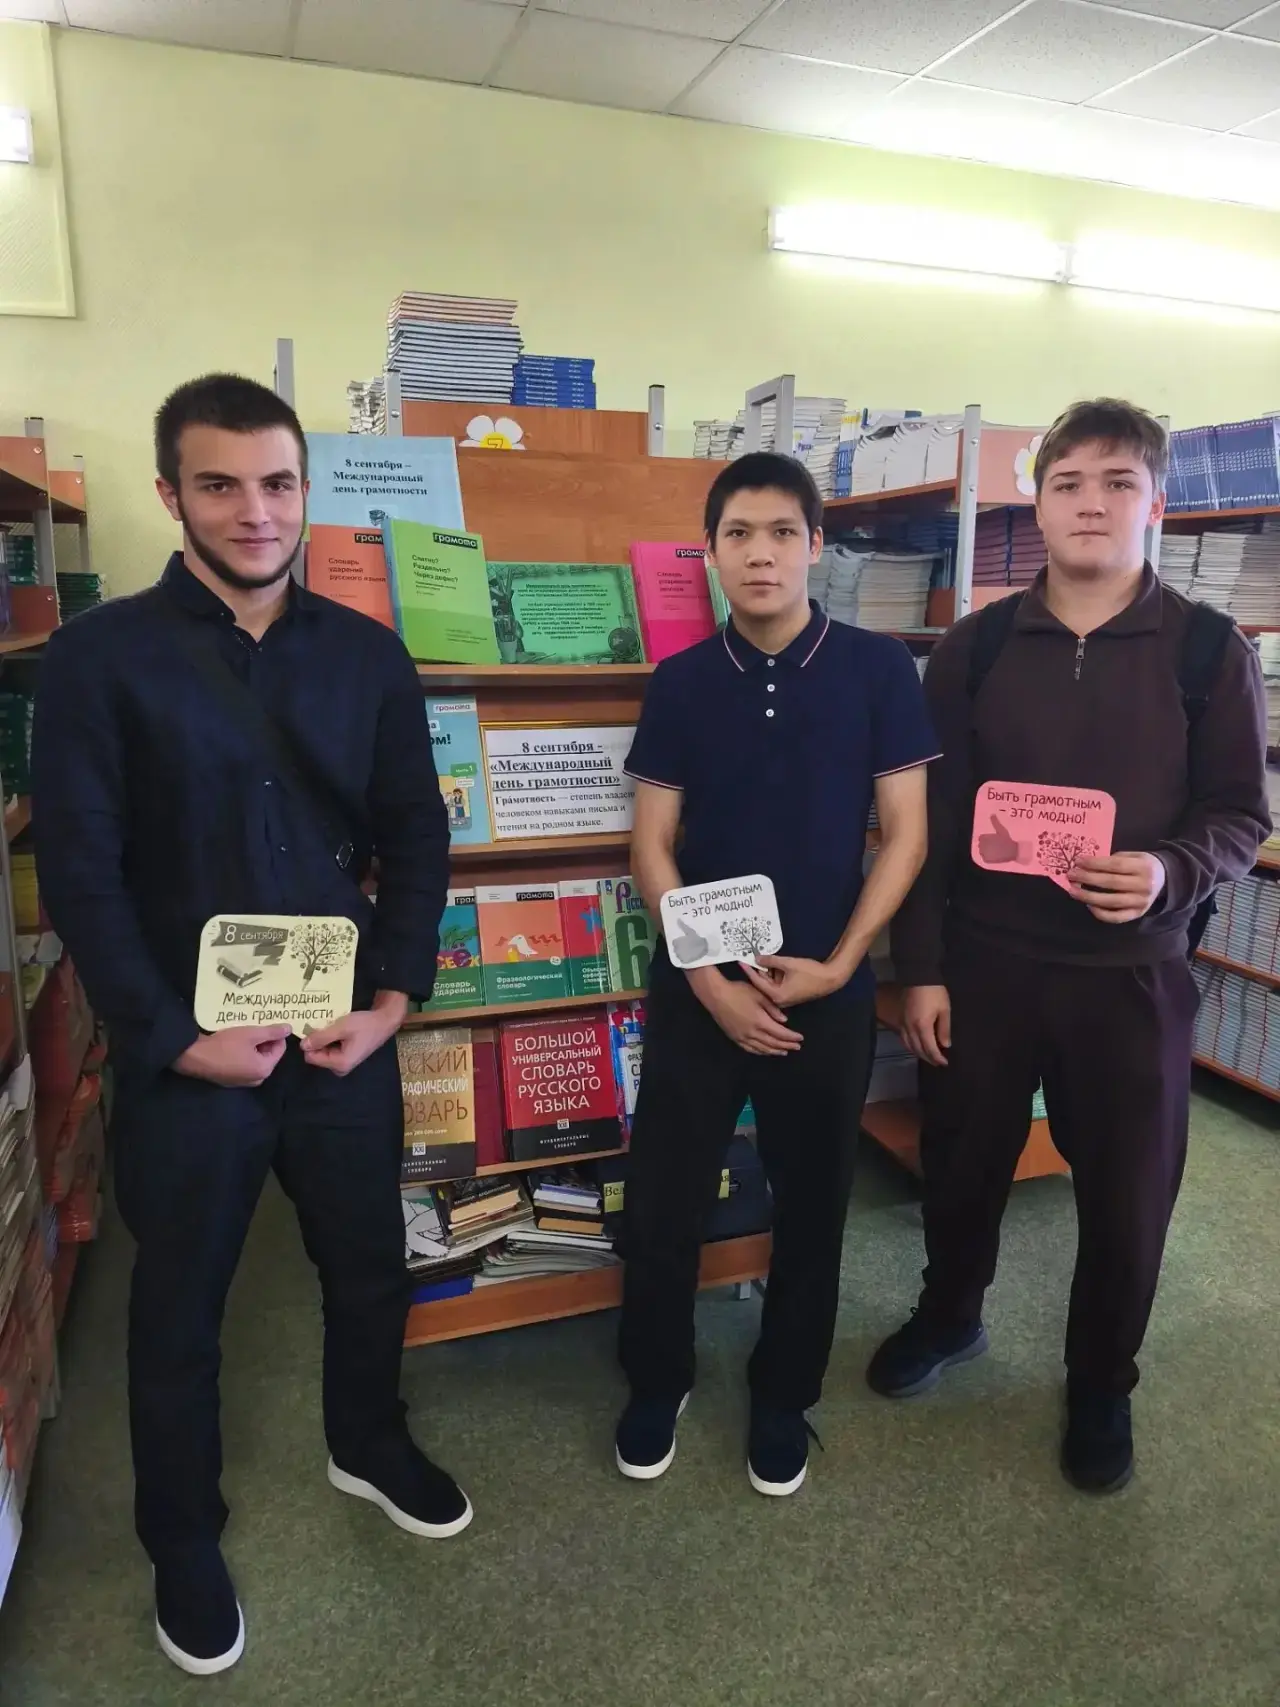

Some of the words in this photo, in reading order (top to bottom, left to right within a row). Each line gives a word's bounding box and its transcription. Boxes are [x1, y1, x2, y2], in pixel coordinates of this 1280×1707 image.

[345, 458, 352, 467] 8
[354, 460, 403, 470] сентября
[333, 471, 424, 483] Международный
[332, 485, 357, 494] день
[360, 486, 428, 496] грамотности
[356, 534, 382, 543] грам
[434, 533, 477, 548] грамота
[677, 549, 707, 557] грамо
[521, 742, 530, 754] 8
[533, 741, 594, 755] сентября
[489, 757, 613, 774] «Международный
[492, 778, 524, 791] день
[527, 775, 621, 790] грамотности»
[570, 793, 603, 801] степень
[987, 787, 1020, 803] Быть
[1024, 793, 1101, 810] грамотным
[496, 808, 542, 818] человеком
[544, 806, 587, 816] навыками
[588, 804, 619, 815] письма
[620, 804, 626, 812] и
[1010, 807, 1034, 819] это
[1038, 810, 1086, 825] модно!
[497, 822, 528, 832] чтения
[529, 822, 540, 830] на
[542, 820, 575, 831] родном
[576, 818, 603, 828] языке.
[516, 892, 555, 901] грамота
[668, 895, 696, 908] Быть
[699, 883, 763, 904] грамотным
[691, 906, 711, 918] это
[715, 895, 754, 913] модно!
[224, 924, 237, 943] 8
[240, 928, 284, 942] сентября
[433, 981, 471, 990] Словарь
[496, 973, 563, 984] Фразеологический
[223, 991, 330, 1008] Международный
[433, 987, 477, 997] ударений
[216, 1010, 248, 1024] день
[252, 1008, 334, 1025] грамотности
[514, 1028, 597, 1052] БОЛЬШОЙ
[407, 1046, 467, 1075] СКИЙ
[512, 1045, 602, 1065] УНИВЕРСАЛЬНЫЙ
[628, 1052, 643, 1062] ФРАЗ
[521, 1060, 596, 1081] СЛОВАРЬ
[402, 1073, 469, 1096] РАФИЧЕСКИЙ
[518, 1076, 601, 1099] РУССКОГО
[403, 1098, 468, 1125] ОВАРЬ
[534, 1094, 590, 1115] ЯЗЫКА
